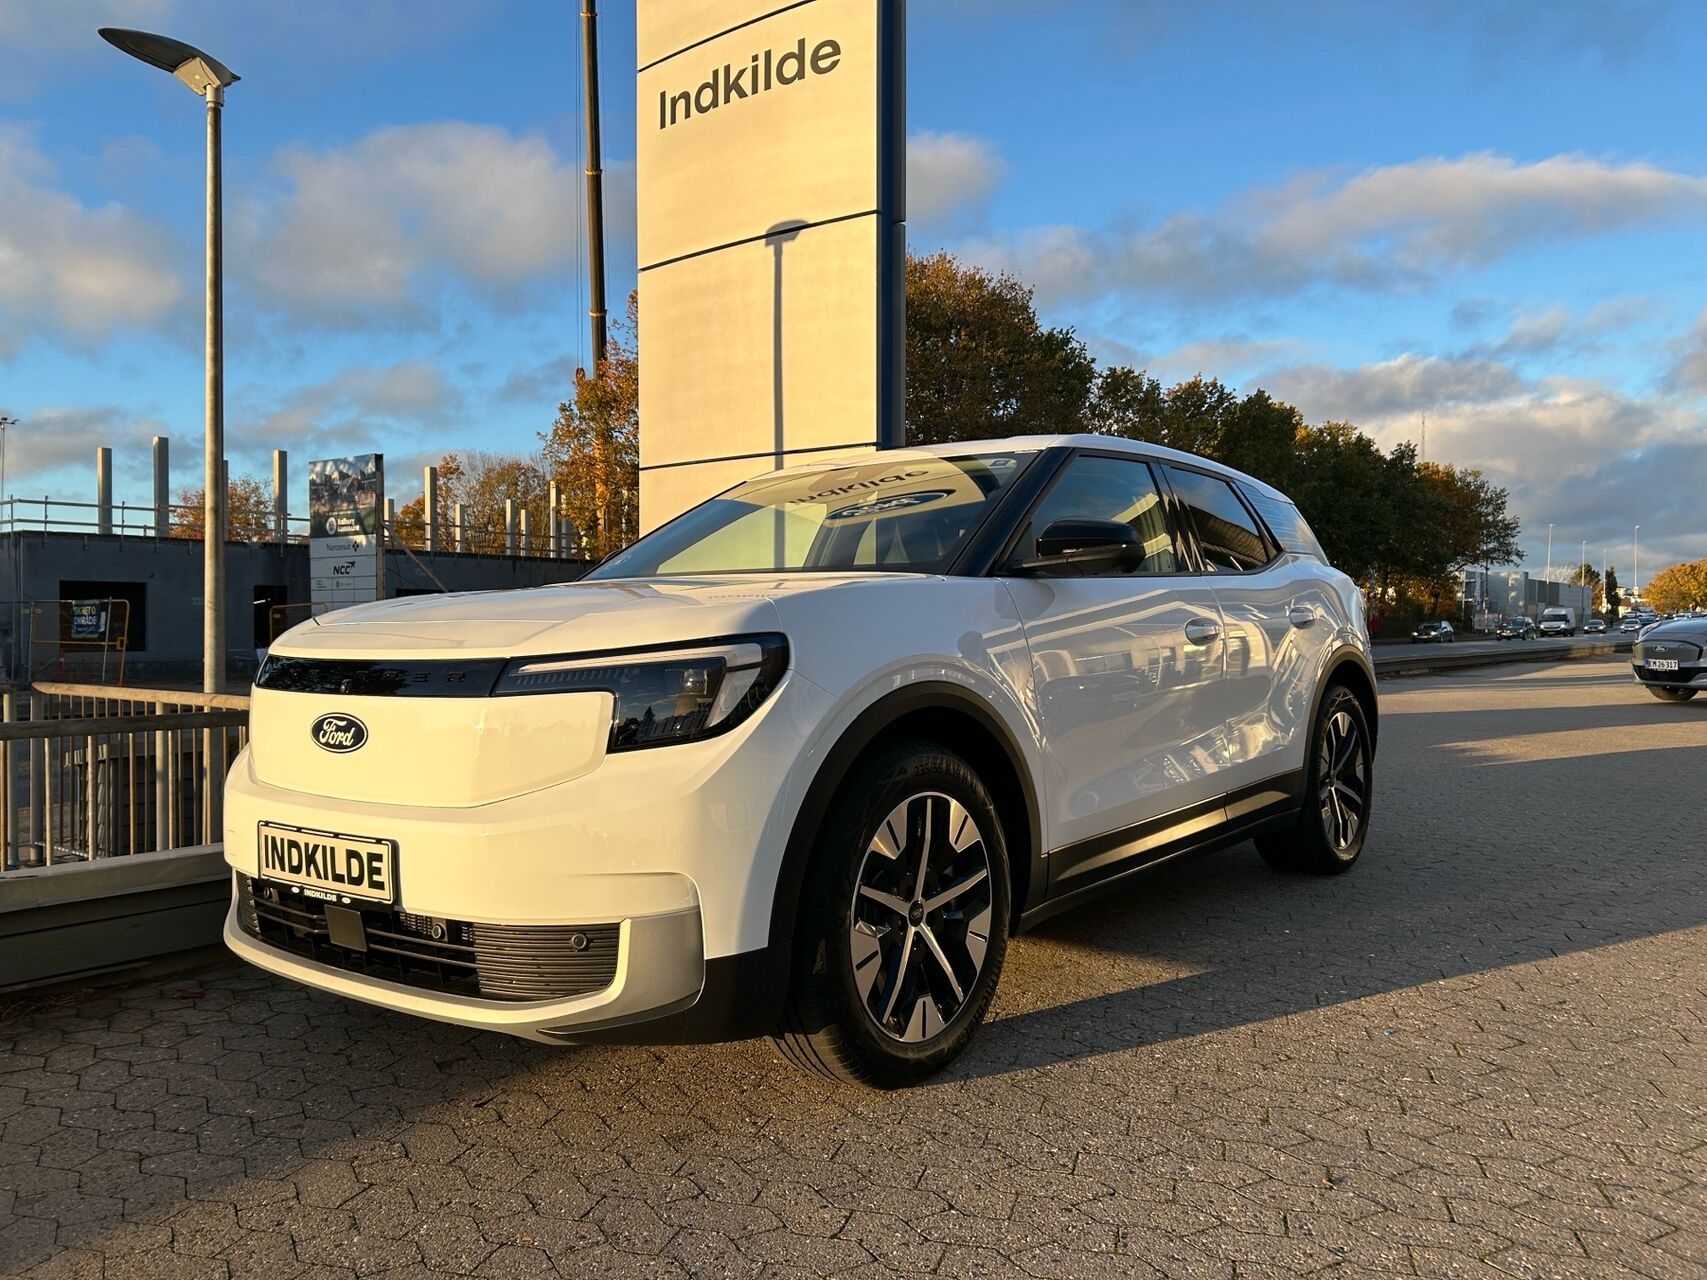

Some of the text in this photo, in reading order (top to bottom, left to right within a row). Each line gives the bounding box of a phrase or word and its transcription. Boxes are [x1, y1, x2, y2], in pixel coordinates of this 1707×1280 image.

[659, 37, 842, 129] Indkilde
[332, 565, 351, 575] NCC
[264, 834, 386, 891] INDKILDE
[303, 888, 338, 902] INDKILDE
